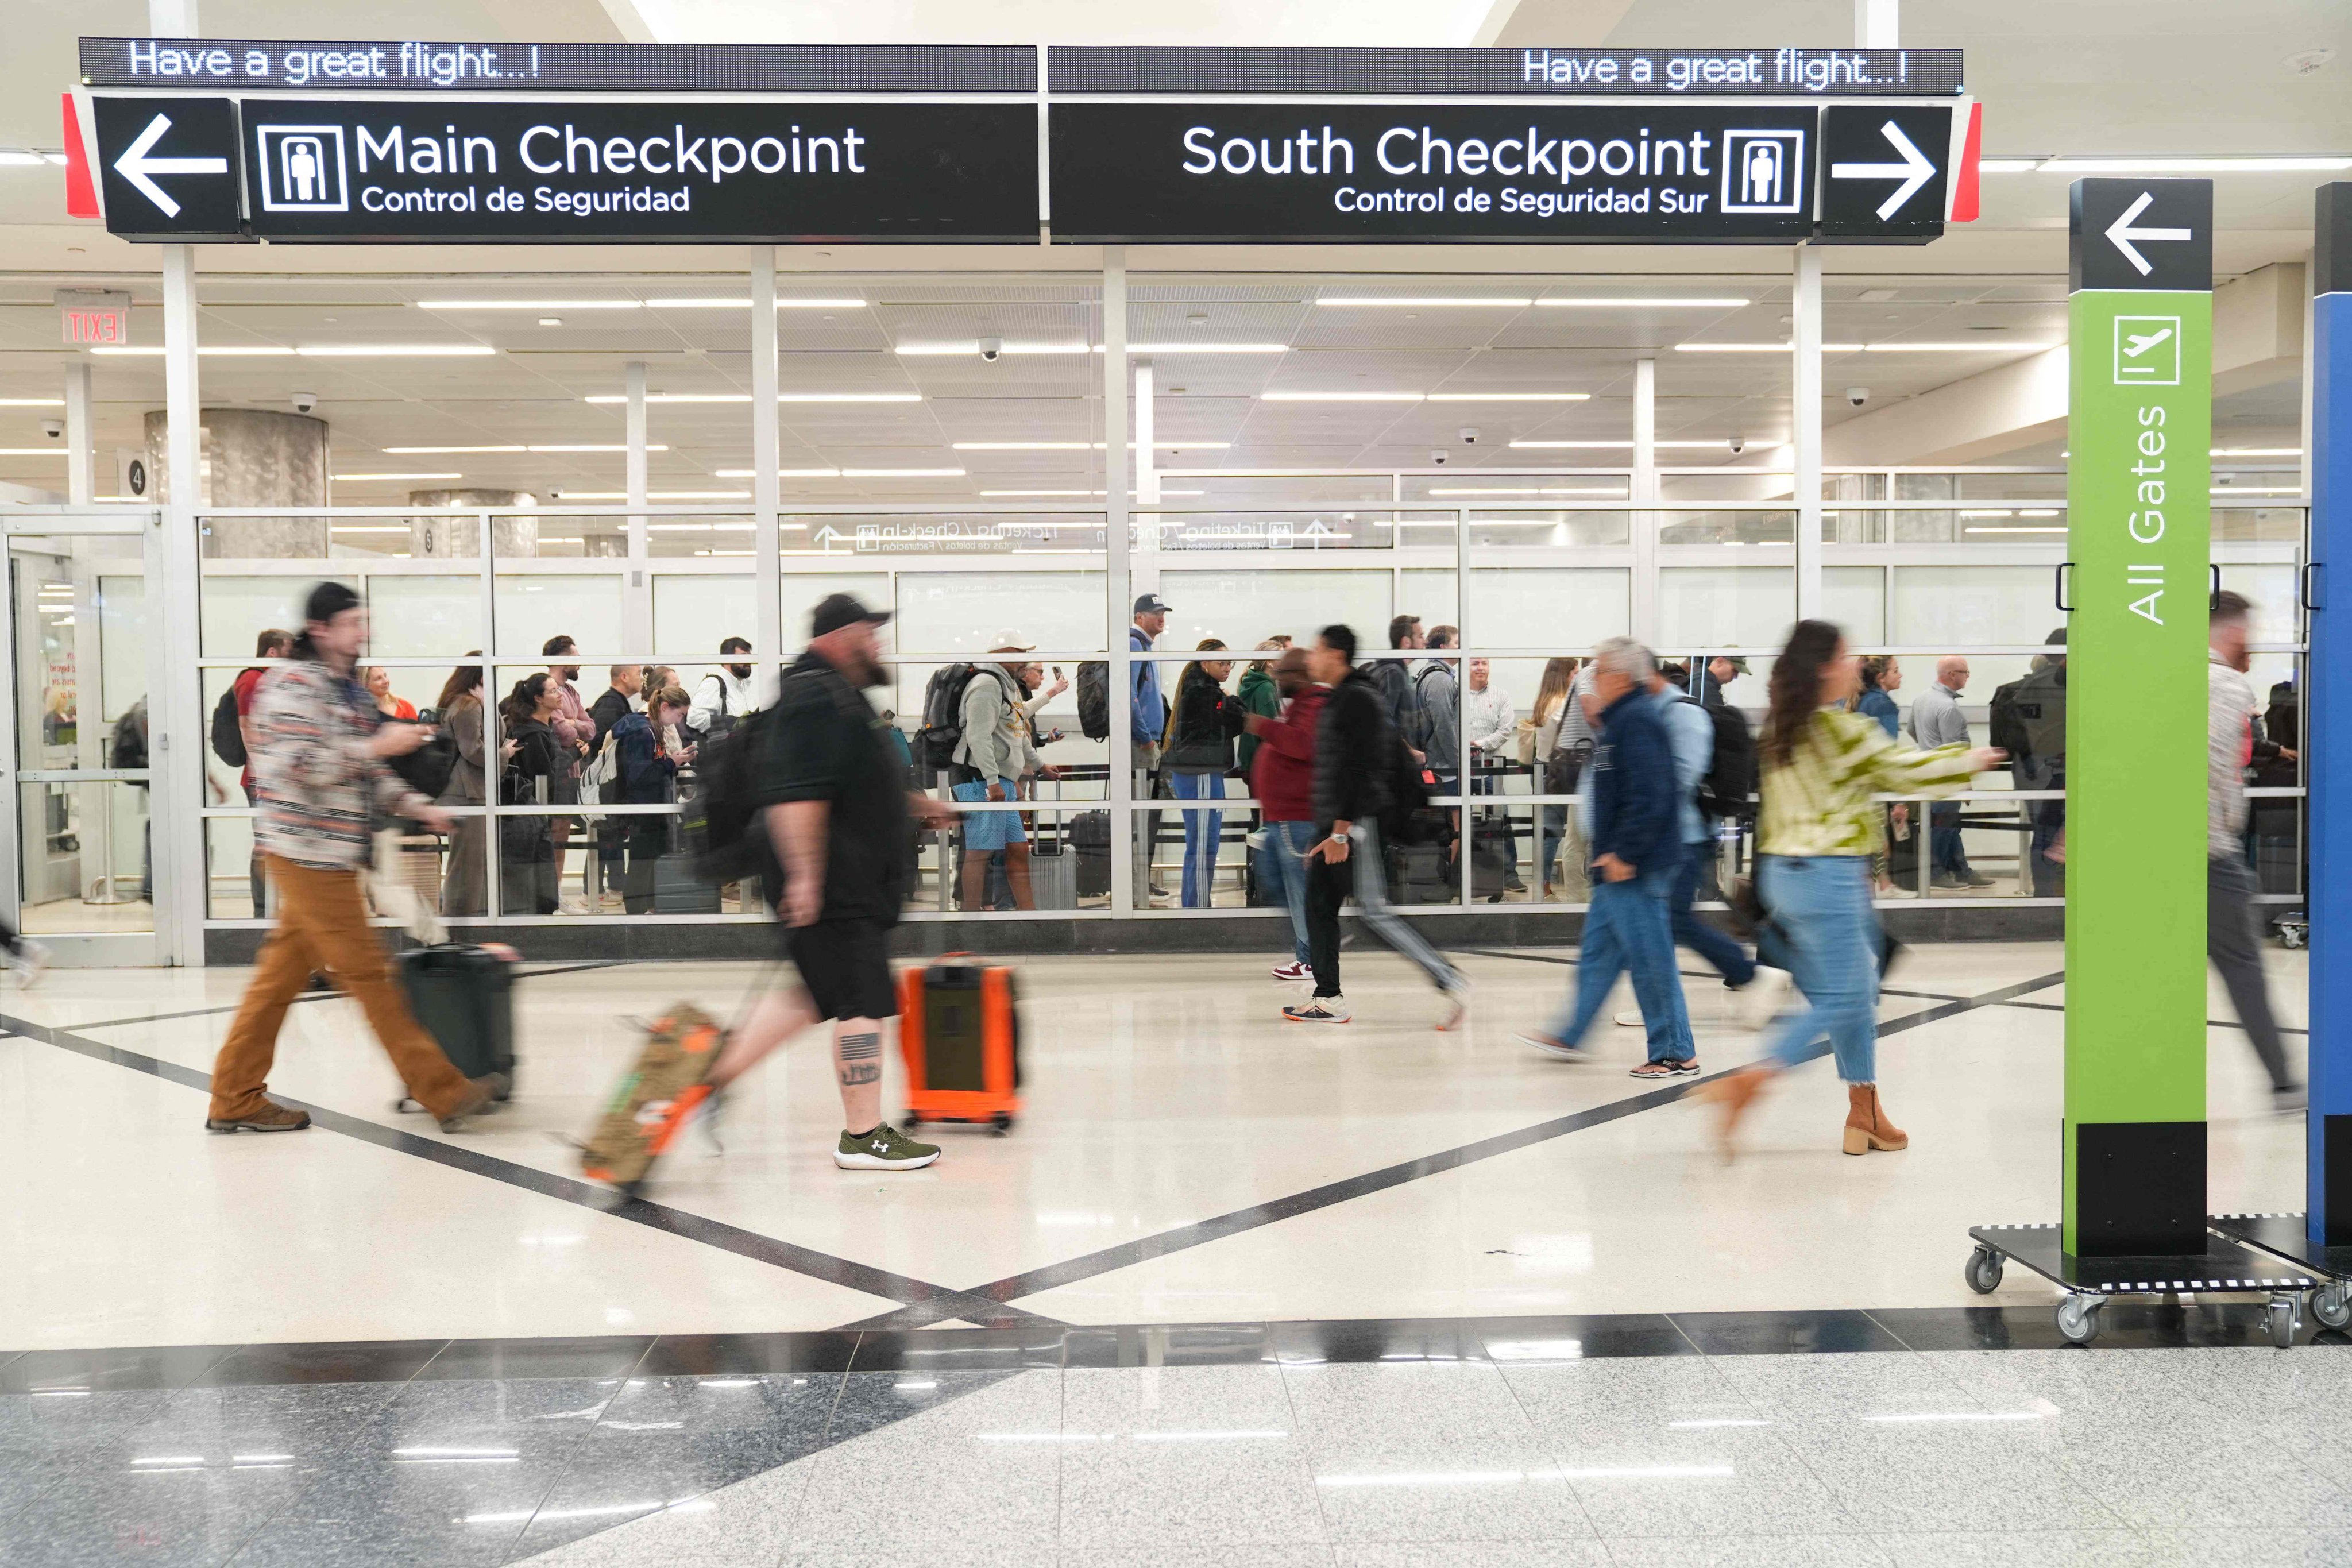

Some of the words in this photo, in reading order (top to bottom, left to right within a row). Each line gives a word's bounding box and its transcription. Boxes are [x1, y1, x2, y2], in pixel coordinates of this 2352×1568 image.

[130, 41, 231, 75] Have
[245, 50, 268, 75] a
[284, 47, 386, 84] great
[1524, 51, 1618, 83] Have
[1631, 58, 1652, 82] a
[1667, 53, 1762, 90] great
[357, 125, 496, 173] Main
[520, 125, 865, 183] Checkpoint
[1182, 126, 1353, 174] South
[1377, 126, 1710, 184] Checkpoint
[362, 186, 476, 212] Control
[486, 187, 524, 212] de
[535, 186, 689, 217] Seguridad
[1335, 187, 1444, 213] Control
[1454, 187, 1490, 213] de
[1500, 188, 1650, 217] Seguridad
[1659, 188, 1709, 213] Sur
[133, 467, 142, 488] 4
[2129, 405, 2166, 544] Gates
[2127, 565, 2164, 625] All
